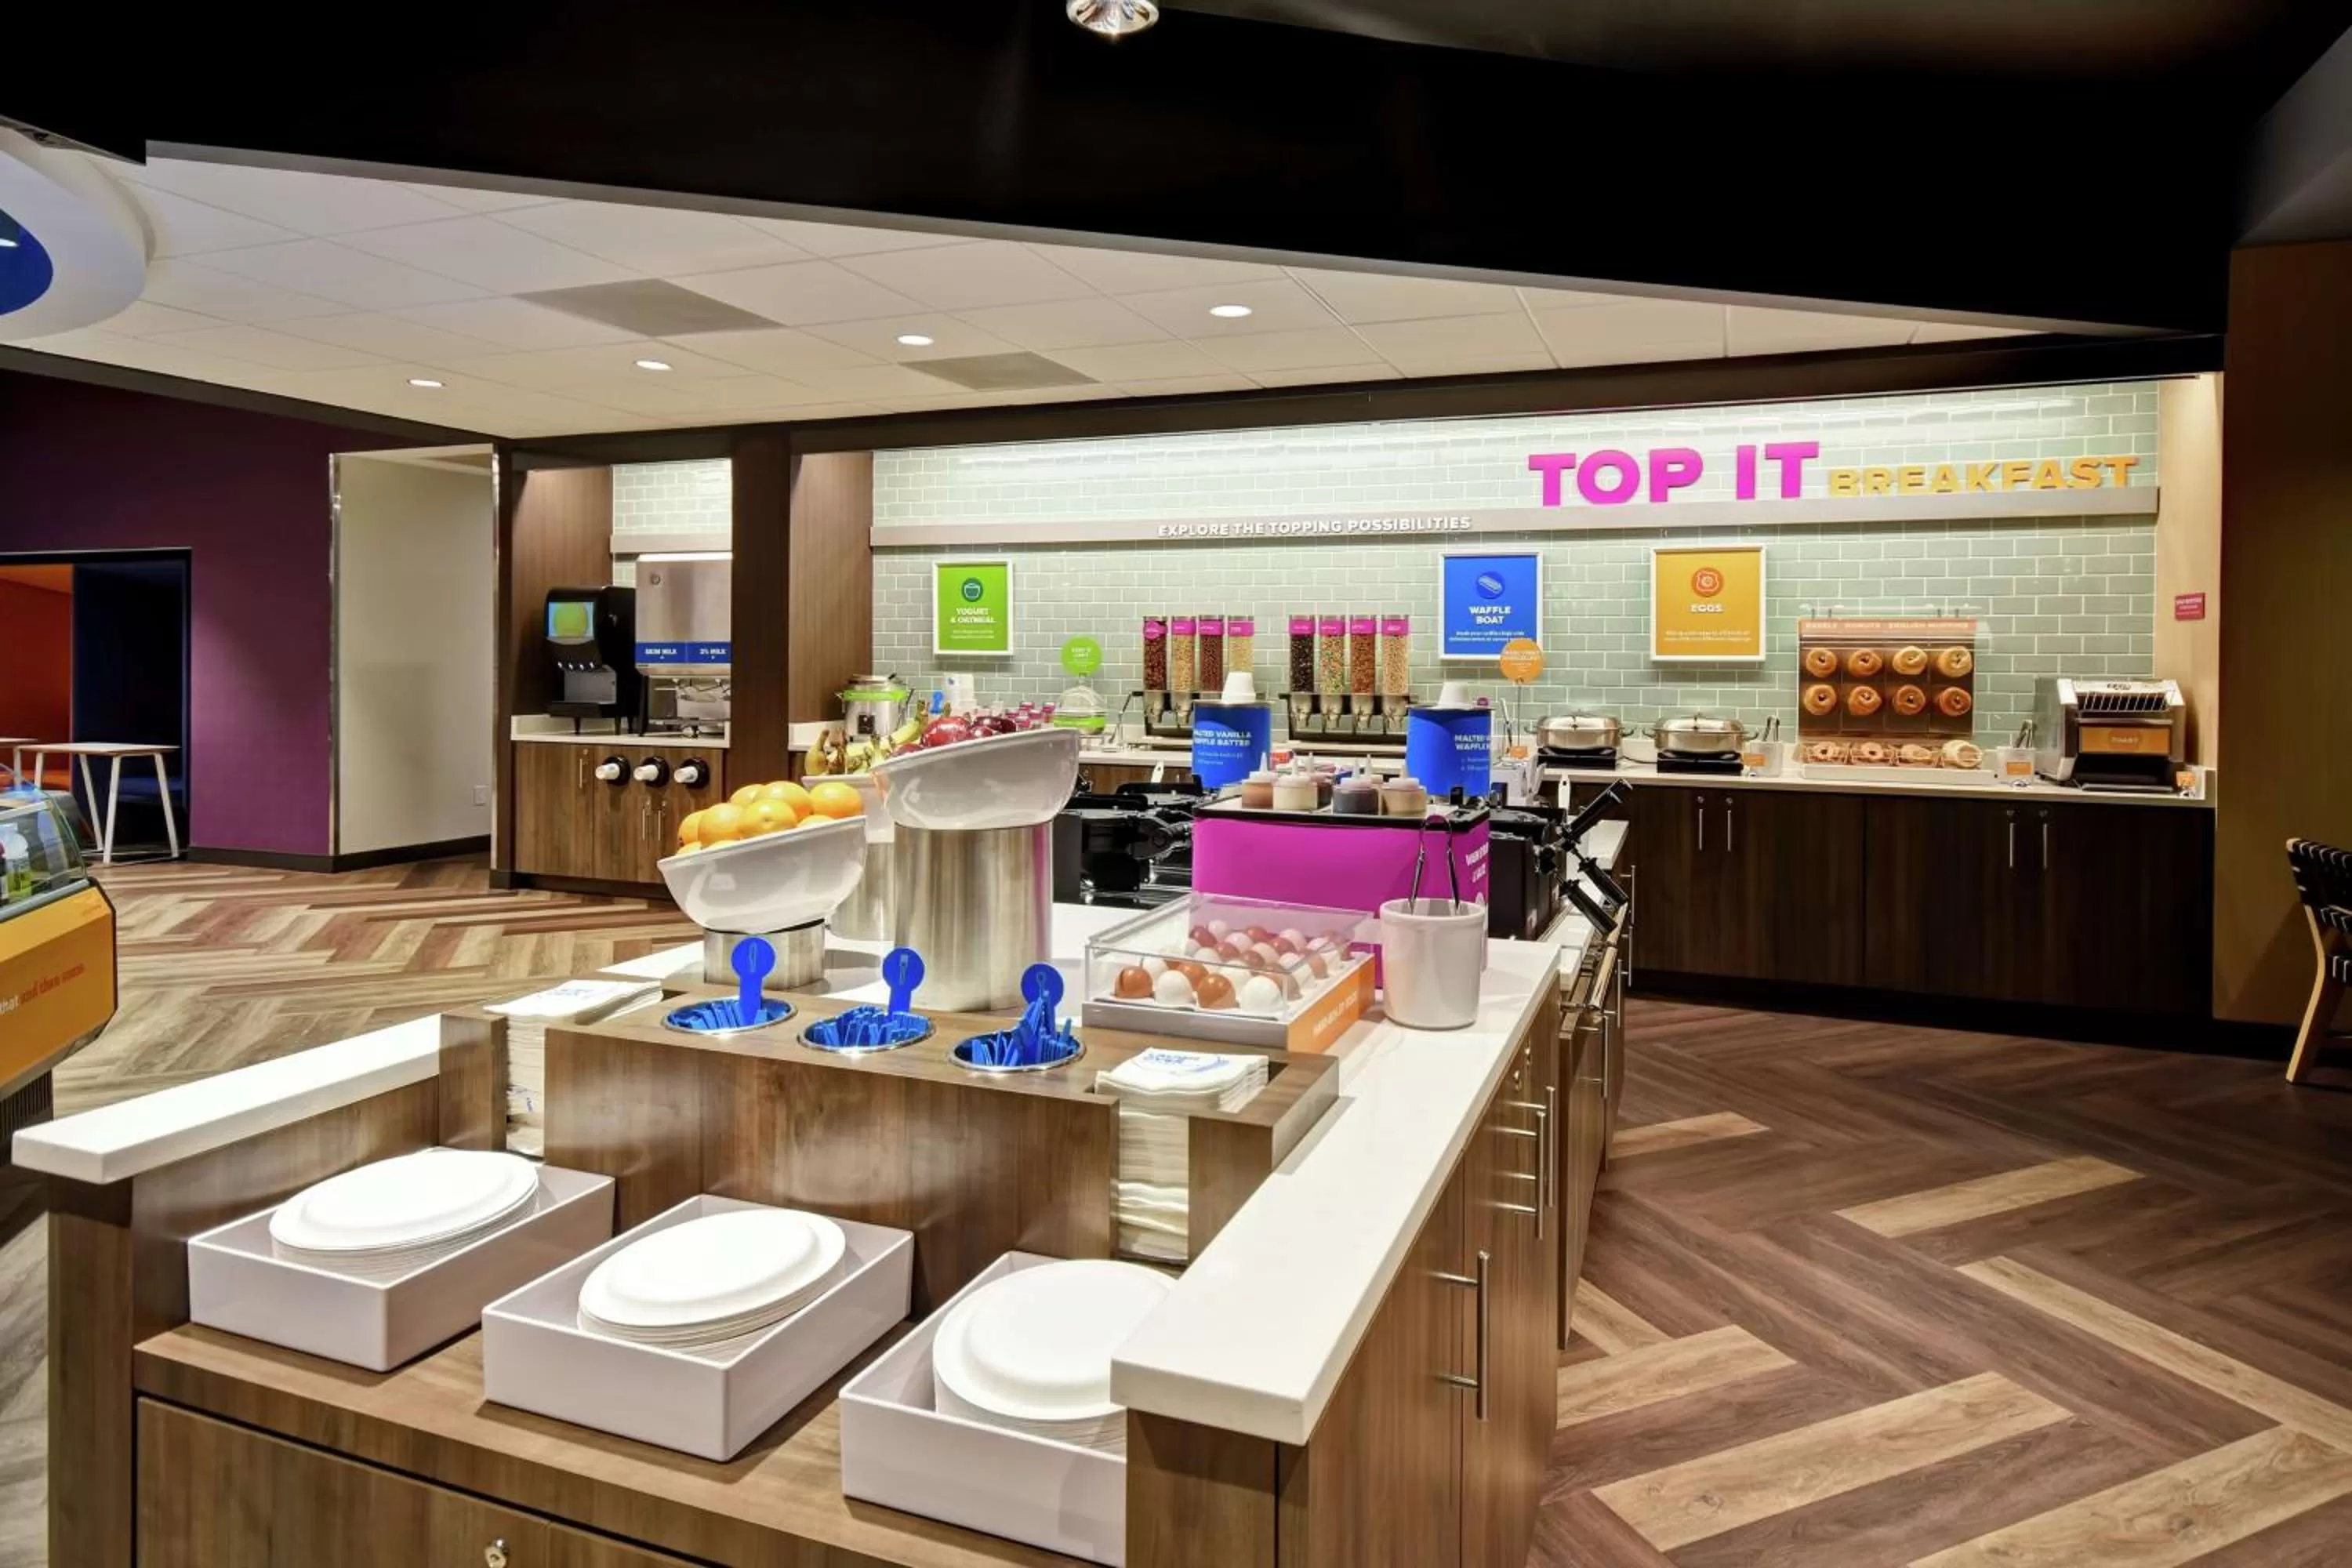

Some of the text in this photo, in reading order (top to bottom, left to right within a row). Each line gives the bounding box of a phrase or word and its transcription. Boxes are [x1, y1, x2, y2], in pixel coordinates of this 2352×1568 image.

[1528, 441, 2140, 506] TOP IT BREAKFAST
[1157, 516, 1472, 537] EXPLORE THE TOPPING POSSIBILITIES
[956, 607, 989, 615] YOGURT
[1468, 605, 1512, 615] WAFFLE
[1690, 604, 1723, 612] EGGS
[1475, 615, 1504, 625] BOAT
[1216, 730, 1252, 740] VANILLA
